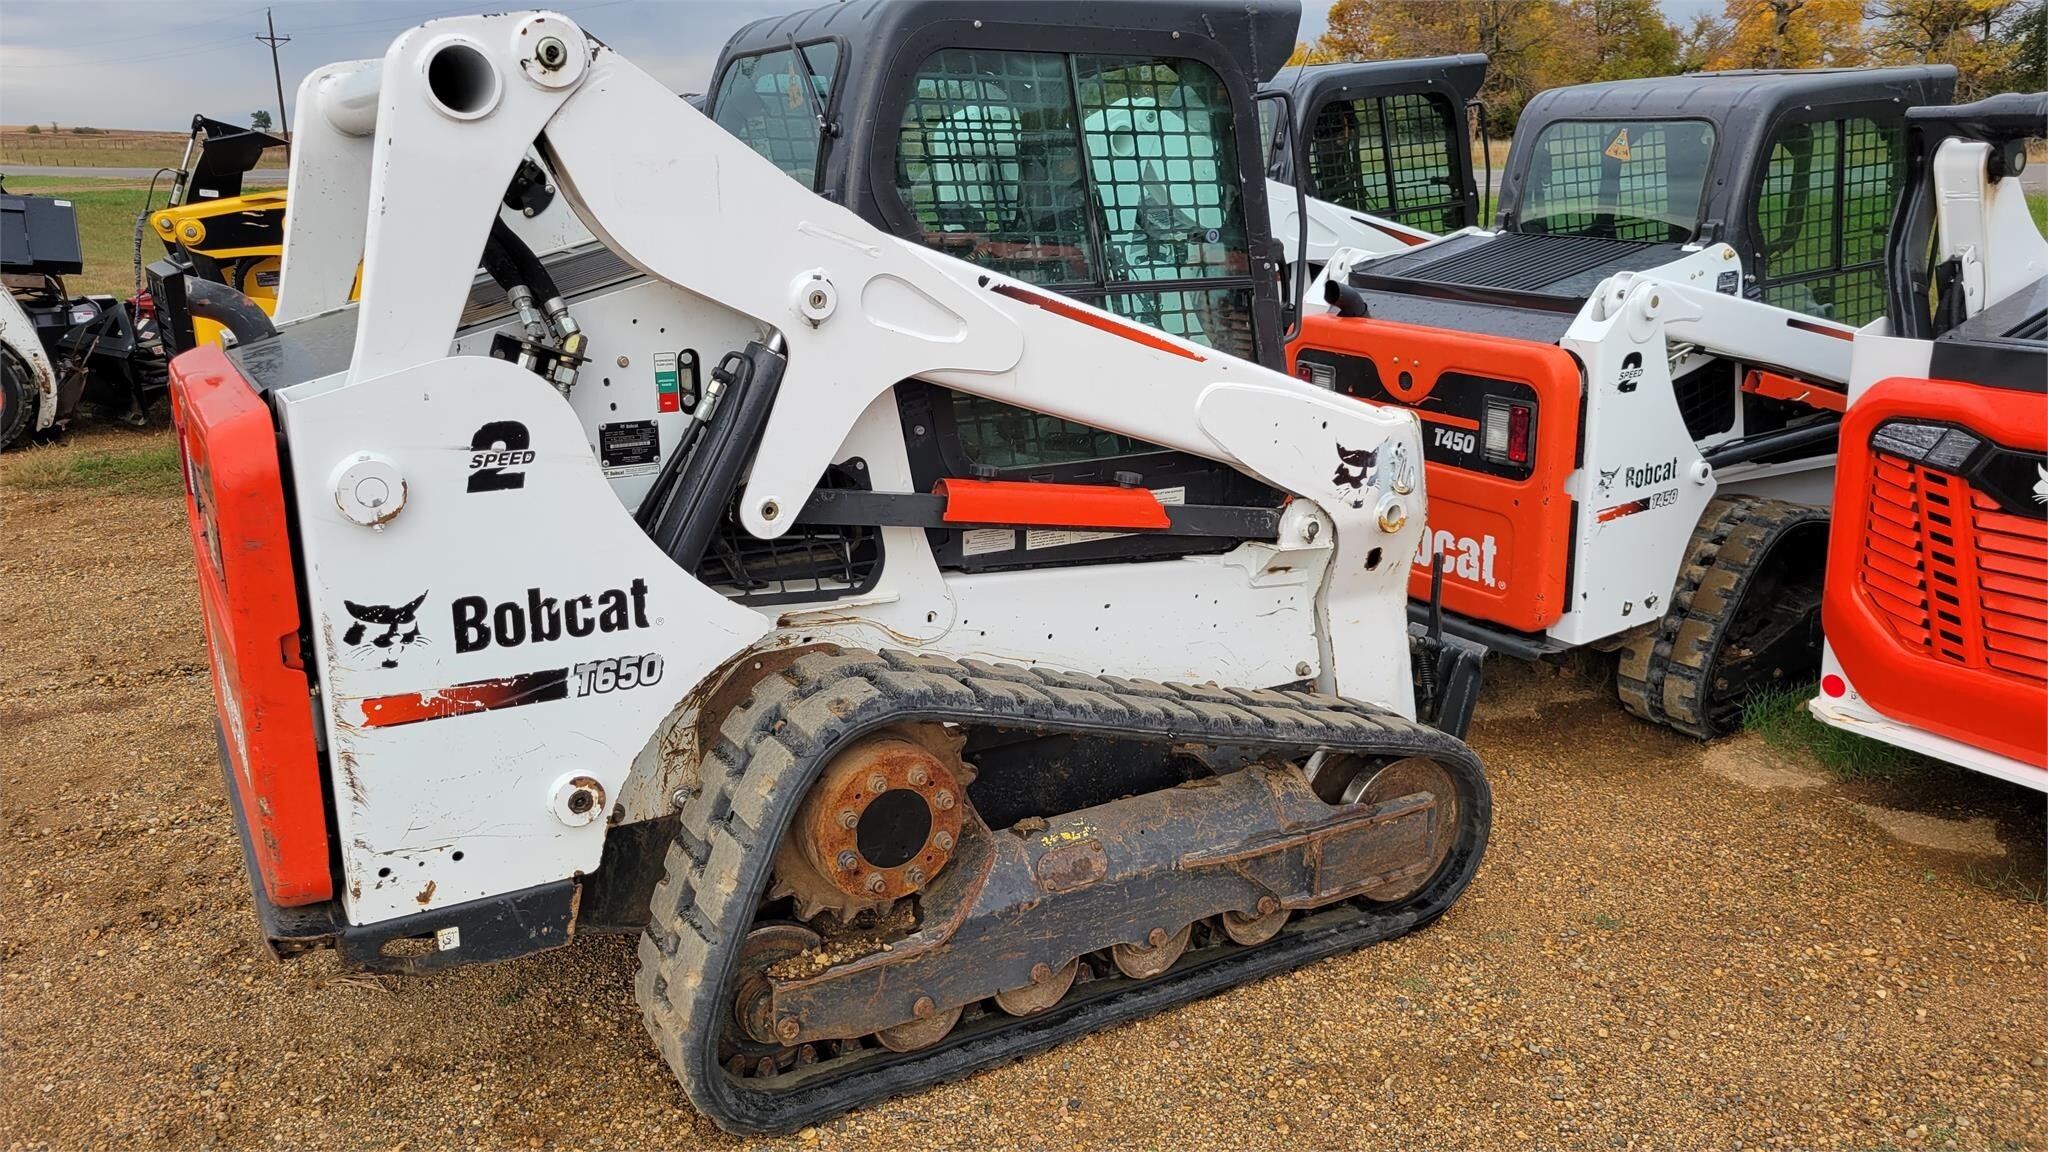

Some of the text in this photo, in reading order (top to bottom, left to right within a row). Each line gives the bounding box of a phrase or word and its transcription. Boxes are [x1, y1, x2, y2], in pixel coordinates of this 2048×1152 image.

[1617, 352, 1642, 393] 2
[1618, 369, 1643, 380] SPEED
[467, 420, 530, 493] 2
[1434, 427, 1476, 454] T450
[469, 450, 536, 469] SPEED
[1651, 488, 1679, 510] T450
[452, 578, 650, 654] Bobcat
[573, 652, 665, 698] T650
